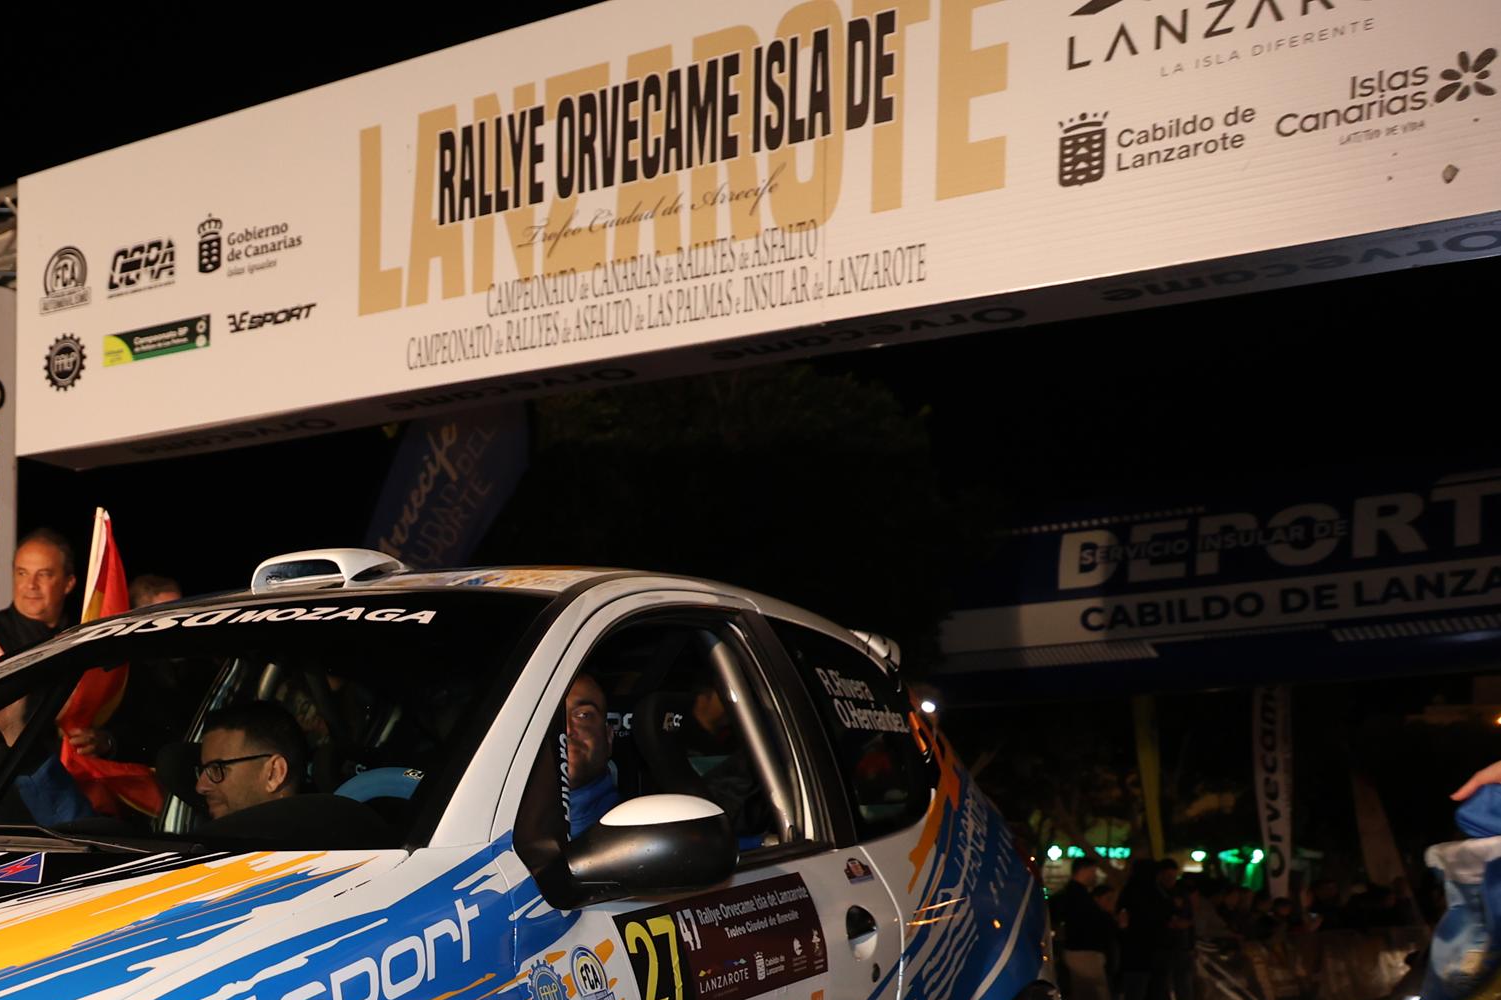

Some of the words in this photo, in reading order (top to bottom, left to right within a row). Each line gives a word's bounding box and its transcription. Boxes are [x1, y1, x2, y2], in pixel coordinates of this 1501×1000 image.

[1159, 63, 1185, 77] LA
[1194, 50, 1241, 69] ISLA
[1251, 17, 1375, 58] DIFERENTE
[1350, 66, 1428, 100] Islas
[437, 104, 545, 226] RALLYE
[555, 52, 740, 199] ORVECAME
[752, 27, 831, 153] ISLA
[845, 9, 897, 131] DE
[1116, 115, 1214, 148] Cabildo
[1223, 105, 1256, 127] de
[1275, 91, 1428, 137] Canarias
[1116, 133, 1246, 171] Lanzarote
[516, 209, 580, 259] Trofeo
[588, 196, 665, 233] Ciudad
[661, 192, 684, 218] de
[690, 163, 787, 217] Arrecife
[227, 222, 288, 246] Gobierno
[227, 248, 242, 262] de
[244, 235, 303, 258] Canarias
[487, 267, 577, 318] CAMPEONATO
[591, 249, 661, 299] CANARIAS
[676, 235, 737, 283] RALLYES
[751, 218, 819, 269] ASFALTO
[406, 322, 493, 371] CAMPEONATO
[505, 309, 560, 354] RALLYES
[572, 297, 633, 343] ASFALTO
[647, 288, 673, 330] LAS
[676, 277, 734, 325] PALMAS
[742, 264, 811, 314] INSULAR
[826, 242, 927, 298] LANZAROTE
[228, 608, 437, 626] MOZAGA
[1081, 592, 1264, 633] CABILDO
[1281, 584, 1339, 614] DE
[676, 909, 702, 951] 47
[695, 908, 722, 927] Rallye
[719, 899, 756, 920] Orvecame
[767, 891, 778, 906] de
[774, 885, 811, 905] Lanzarote
[580, 963, 601, 990] FCA
[699, 967, 749, 994] LANZAROTE
